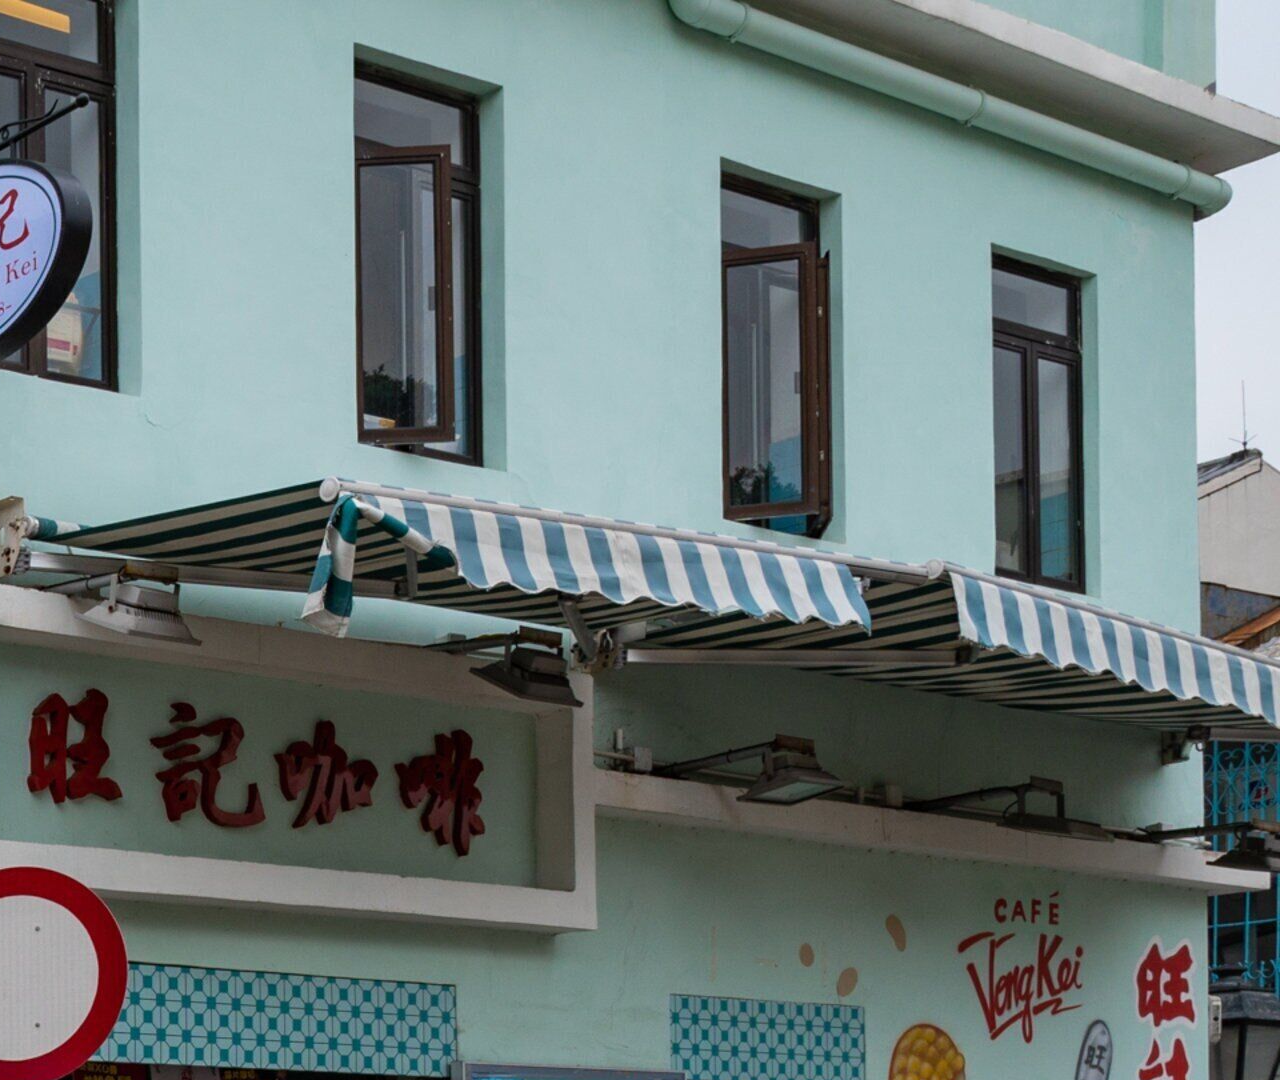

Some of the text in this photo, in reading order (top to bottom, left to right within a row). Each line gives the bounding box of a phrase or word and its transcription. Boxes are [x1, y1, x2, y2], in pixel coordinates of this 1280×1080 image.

[5, 250, 40, 285] Kei
[28, 688, 486, 857] 旺記咖啡
[994, 892, 1060, 925] CAFÉ
